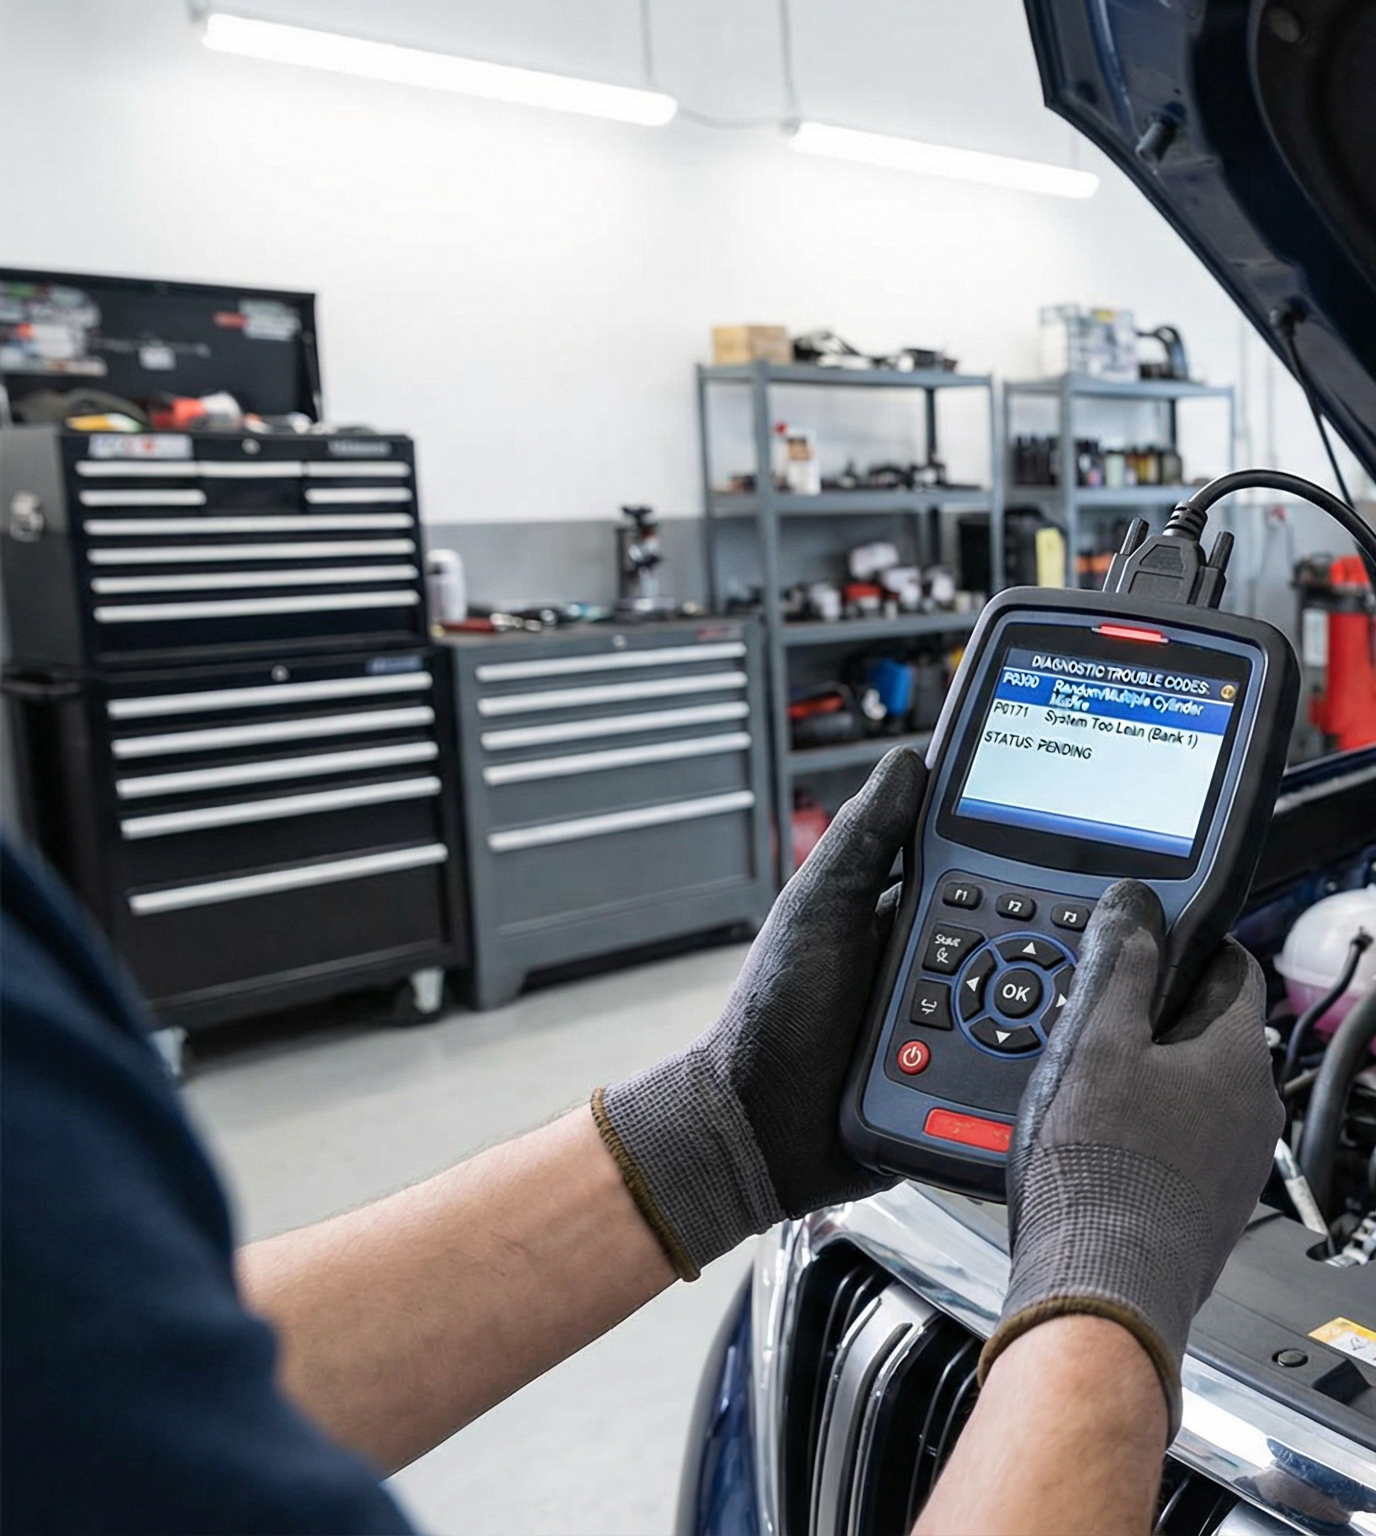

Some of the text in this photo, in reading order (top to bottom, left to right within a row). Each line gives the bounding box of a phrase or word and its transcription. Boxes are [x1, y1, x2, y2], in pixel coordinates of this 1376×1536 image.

[1106, 666, 1164, 688] TROUBLE
[1091, 717, 1114, 732] Too
[1187, 733, 1199, 749] 1)
[1037, 738, 1093, 760] PENDING
[1008, 900, 1022, 912] F2
[1063, 911, 1078, 923] F3
[1002, 983, 1031, 1003] OK
